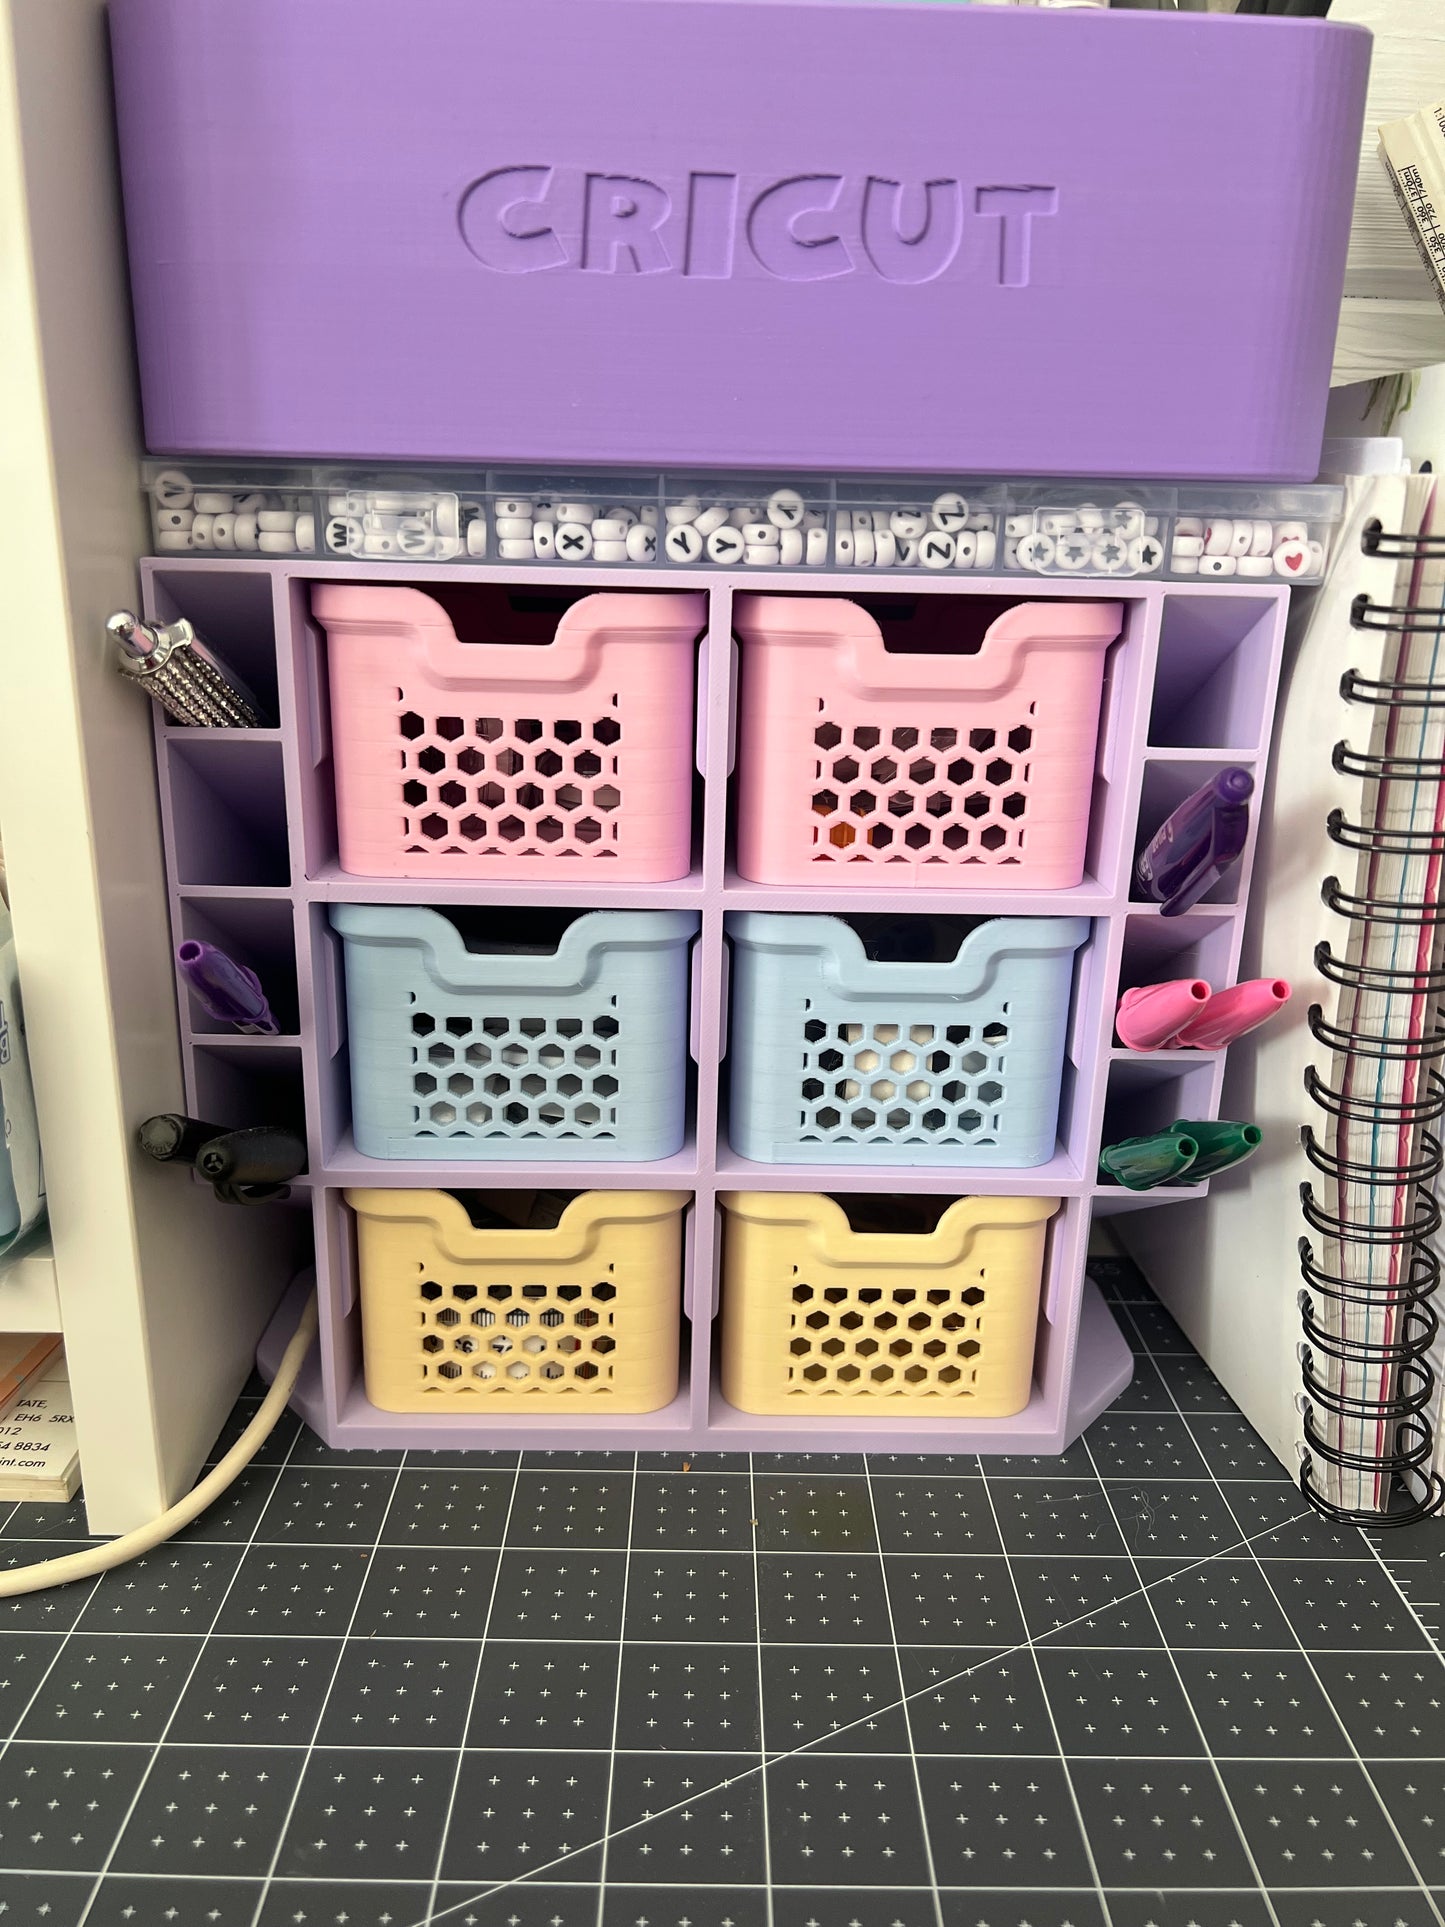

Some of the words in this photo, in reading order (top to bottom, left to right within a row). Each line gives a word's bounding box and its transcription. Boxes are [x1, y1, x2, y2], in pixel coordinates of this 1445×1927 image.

[1433, 107, 1445, 137] 1:100
[1403, 171, 1417, 197] 370m
[1412, 168, 1426, 195] 740m
[1417, 206, 1428, 223] 360
[1425, 203, 1437, 220] 720
[457, 164, 1059, 288] CRICUT
[1429, 236, 1441, 253] 350
[562, 534, 584, 550] X
[673, 532, 691, 554] Y
[716, 538, 737, 554] Y
[14, 1413, 42, 1422] EH6
[48, 1414, 75, 1423] 5RX
[13, 1441, 51, 1451] 8834
